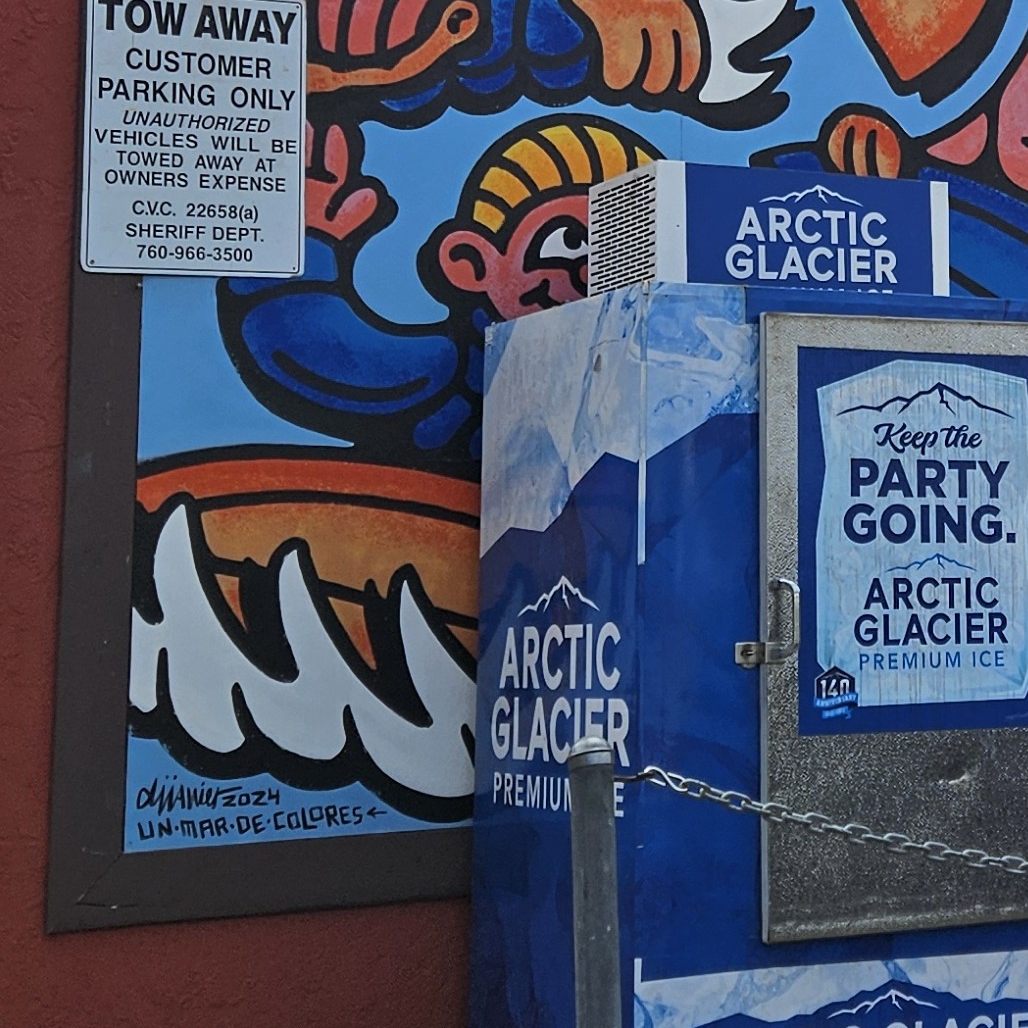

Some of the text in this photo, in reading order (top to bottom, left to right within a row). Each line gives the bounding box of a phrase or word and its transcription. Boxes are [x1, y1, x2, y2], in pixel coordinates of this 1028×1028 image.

[194, 4, 297, 45] AWAY
[125, 48, 271, 79] CUSTOMER
[98, 77, 296, 111] PARKING ONLY
[122, 109, 271, 133] UNAUTHORIZED
[94, 129, 298, 154] VEHICLES WILL BE
[116, 151, 276, 173] TOWED AWAY AT
[104, 170, 286, 192] OWNERS EXPENSE
[132, 200, 259, 223] C.V.C. 22658(a)
[736, 206, 888, 246] ARCTIC
[125, 223, 264, 242] SHERIFF DEPT.
[136, 244, 253, 262] 760-966-3500
[725, 243, 898, 284] GLACIER
[874, 423, 982, 455] Keep the
[851, 458, 1010, 499] PARTY
[843, 503, 1017, 545] GOING.
[864, 577, 999, 610] ARCTIC
[854, 612, 1008, 647] GLACIER
[499, 622, 621, 691] ARCTIC
[859, 650, 1005, 671] PREMIUM ICE
[491, 696, 630, 767] GLACIER
[222, 788, 280, 807] 2024
